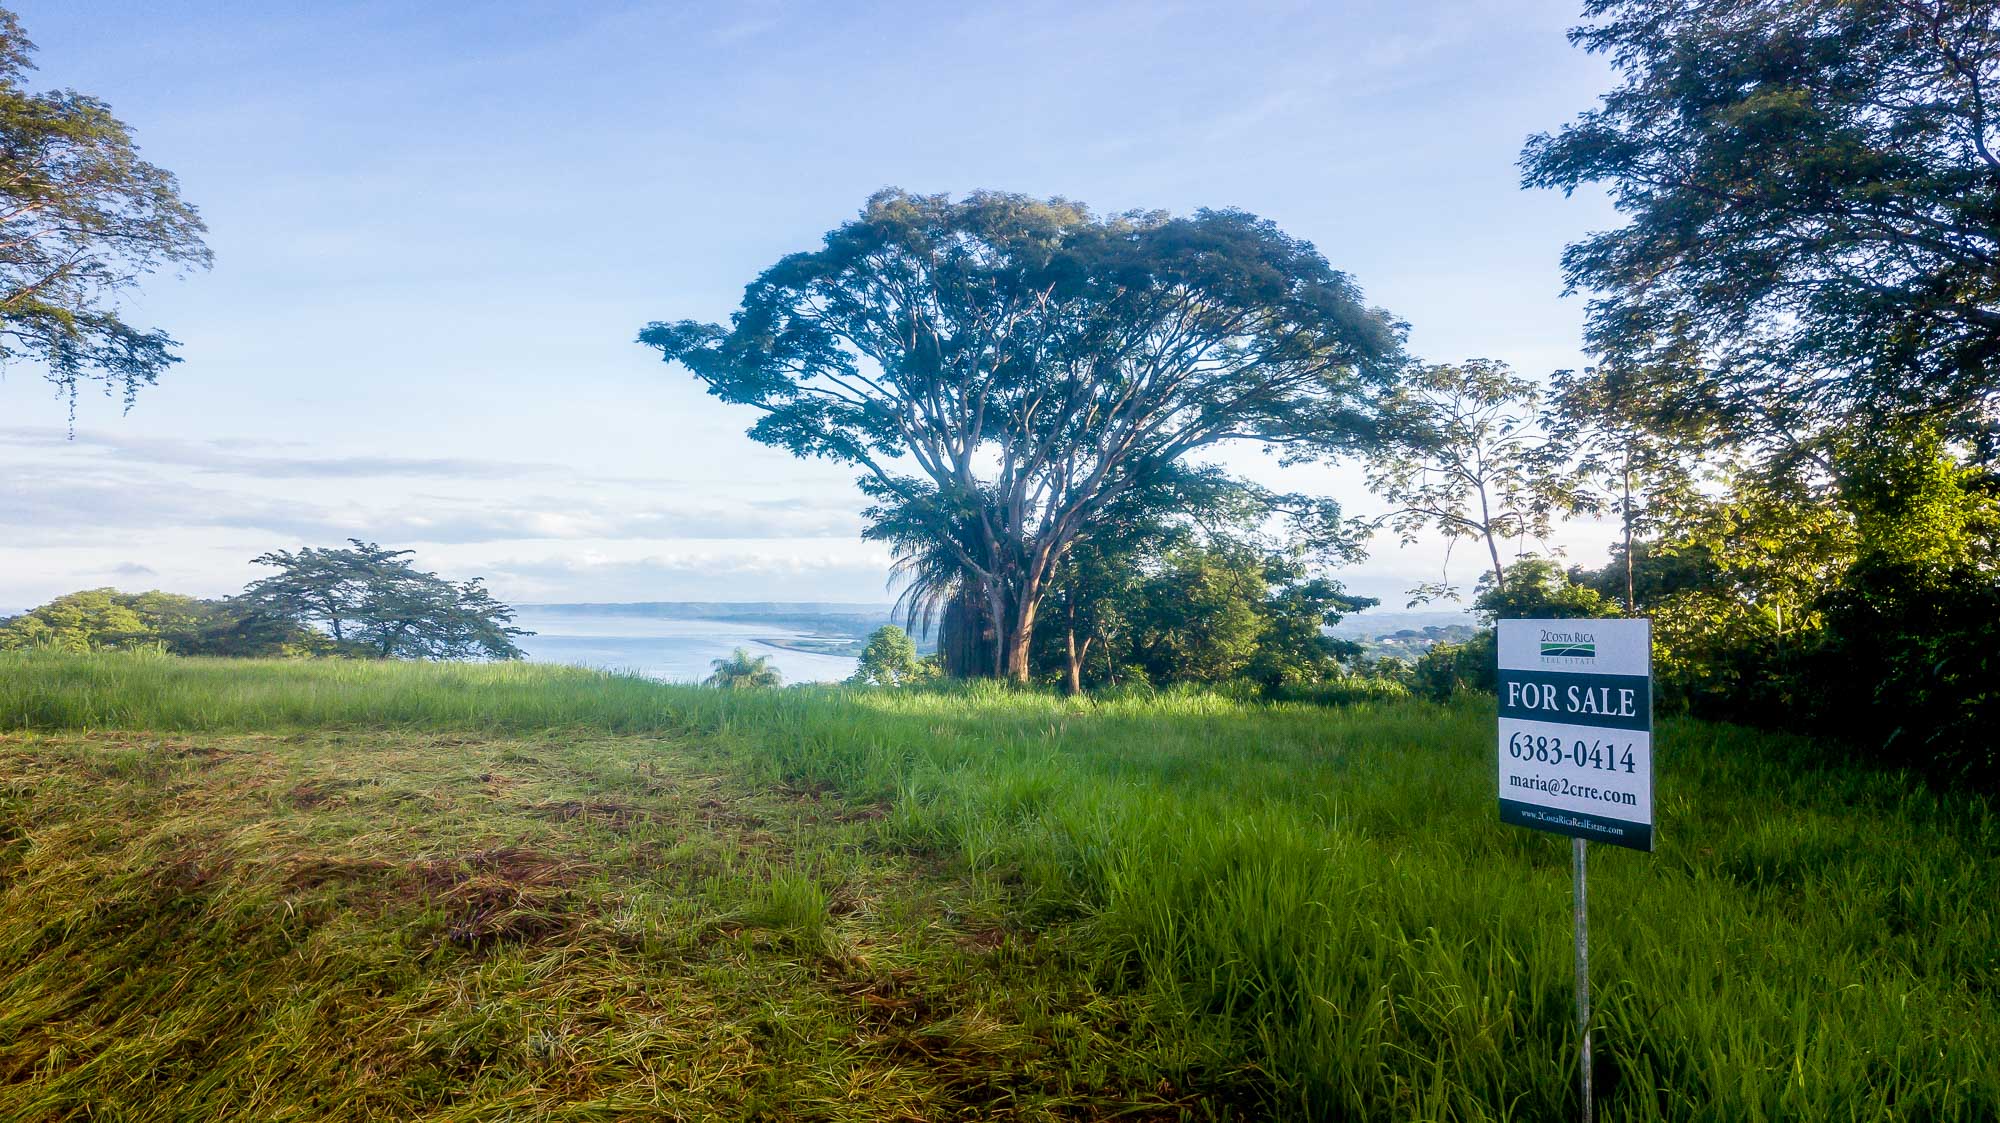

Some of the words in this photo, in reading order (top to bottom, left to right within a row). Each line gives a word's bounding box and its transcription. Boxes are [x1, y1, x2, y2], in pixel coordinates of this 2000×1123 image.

[1507, 681, 1560, 711] FOR
[1567, 685, 1636, 717] SALE
[1509, 731, 1636, 774] 6383-0414
[1509, 774, 1637, 806] maria@2crre.com
[1521, 809, 1624, 836] www.2CostaRicaRealEstate.com
